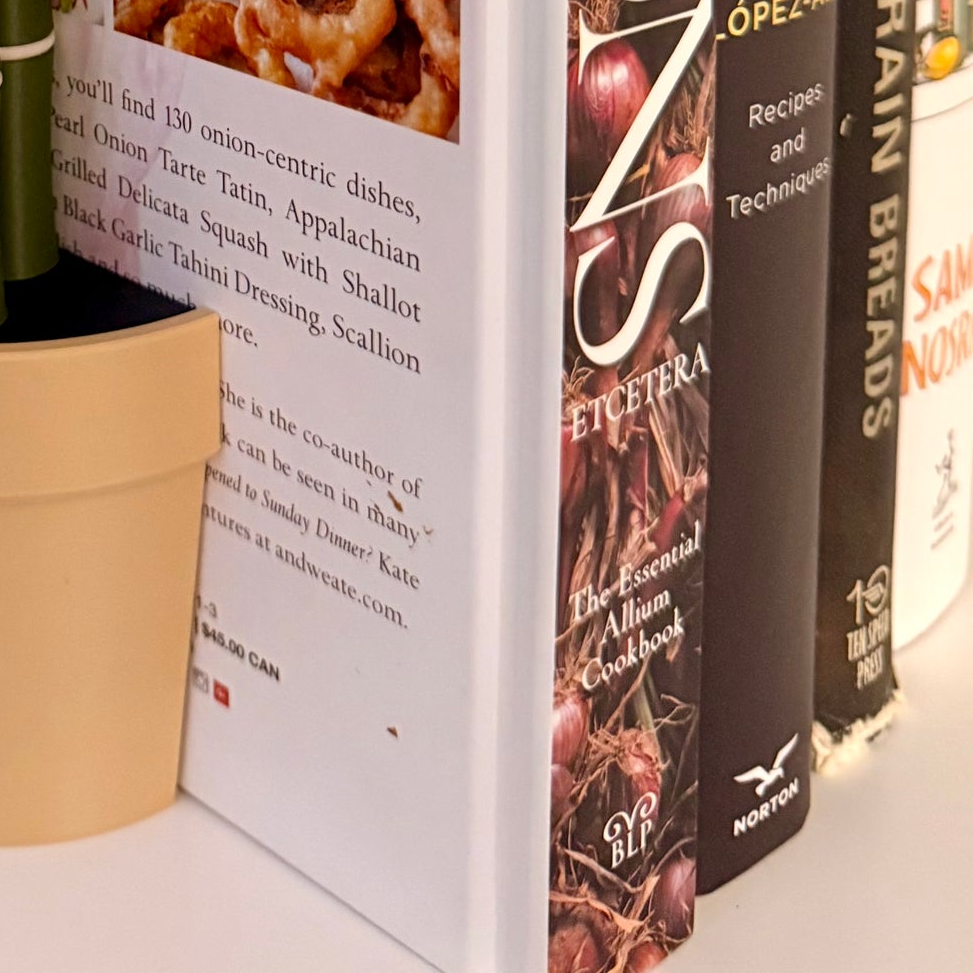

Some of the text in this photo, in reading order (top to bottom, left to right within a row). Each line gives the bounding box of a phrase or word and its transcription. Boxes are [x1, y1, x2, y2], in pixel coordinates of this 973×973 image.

[67, 76, 421, 225] you’ll find 130 onion-centric dishes,
[748, 81, 824, 128] Recipes
[769, 128, 805, 164] and
[51, 148, 421, 323] Grilled Delicata Squash with Shallot
[94, 123, 148, 162] Onion
[158, 146, 207, 186] Tarte
[216, 169, 273, 217] Tatin,
[285, 198, 421, 273] Appalachian
[726, 155, 831, 220] Techniques
[63, 194, 107, 233] Black
[112, 218, 164, 258] Garlic
[168, 241, 229, 288] Tahini
[235, 269, 326, 337] Dressing,
[332, 313, 421, 375] Scallion
[219, 318, 259, 347] ore.
[862, 193, 903, 439] BREADS
[220, 380, 423, 499] She is the co-author of
[571, 342, 710, 443] ETCETERA
[237, 438, 420, 549] can be seen in many
[245, 483, 257, 501] to
[261, 490, 310, 536] Sunday
[315, 518, 373, 563] Dinner?
[379, 551, 420, 590] Kate
[255, 533, 270, 552] at
[275, 542, 408, 629] andweate.com.
[569, 519, 701, 622] The Essential
[601, 589, 670, 643] Allium
[248, 651, 280, 681] CAN
[582, 606, 685, 691] Cookbook
[846, 625, 867, 661] TEN
[611, 819, 653, 868] BLP
[733, 777, 799, 837] NORTON
